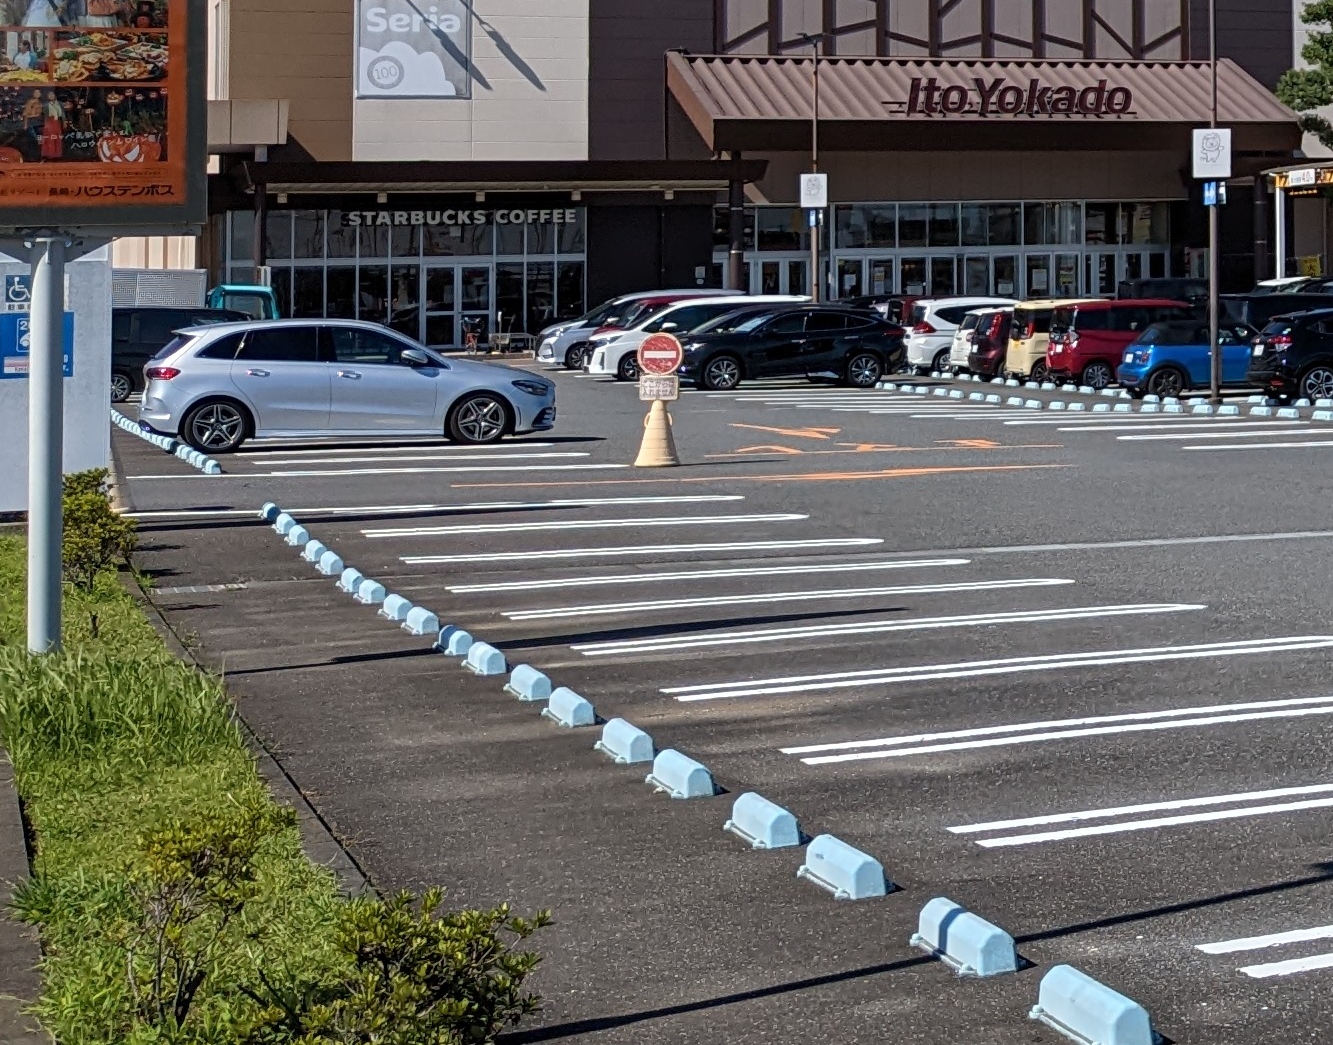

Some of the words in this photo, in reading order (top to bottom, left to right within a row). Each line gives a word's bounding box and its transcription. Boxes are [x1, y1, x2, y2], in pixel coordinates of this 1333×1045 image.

[366, 6, 461, 33] Seria
[375, 66, 398, 79] 100
[349, 210, 486, 225] STARBUCKS
[495, 209, 576, 224] COFFEE
